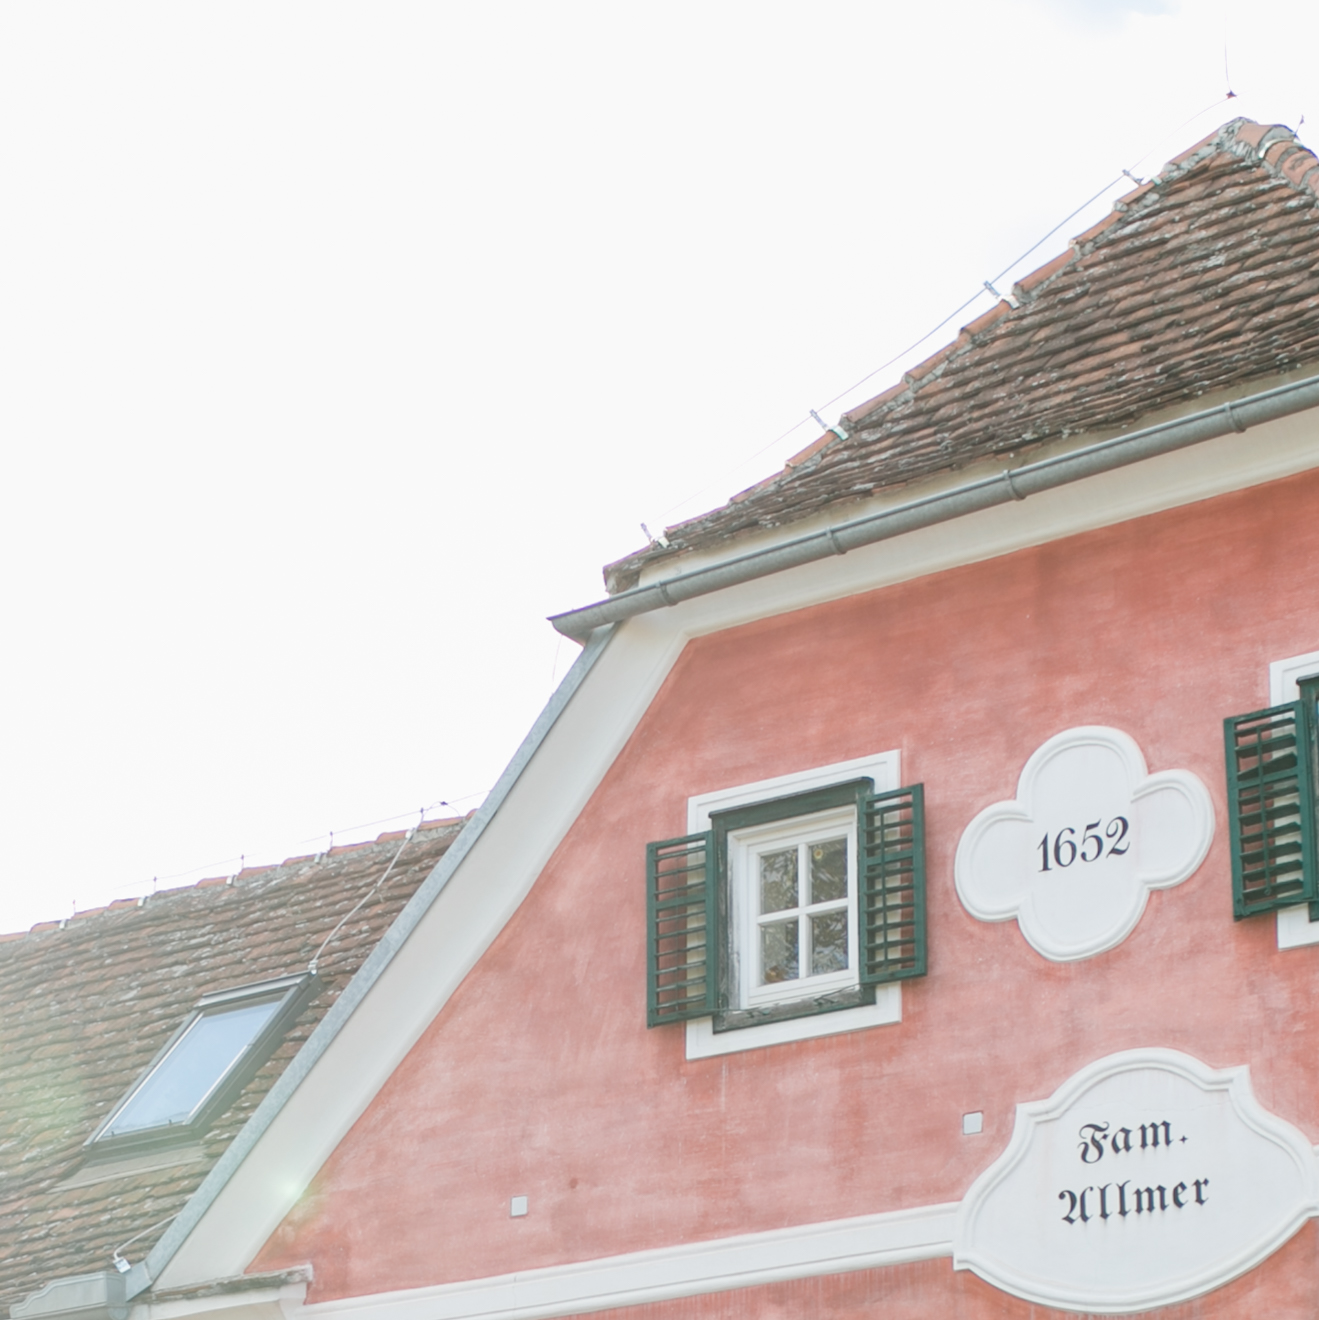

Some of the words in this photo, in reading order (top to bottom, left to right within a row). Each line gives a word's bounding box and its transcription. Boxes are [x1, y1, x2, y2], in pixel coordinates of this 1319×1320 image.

[1036, 815, 1131, 873] 1652
[1077, 1120, 1189, 1165] Fam.
[1058, 1177, 1210, 1226] Allmer
